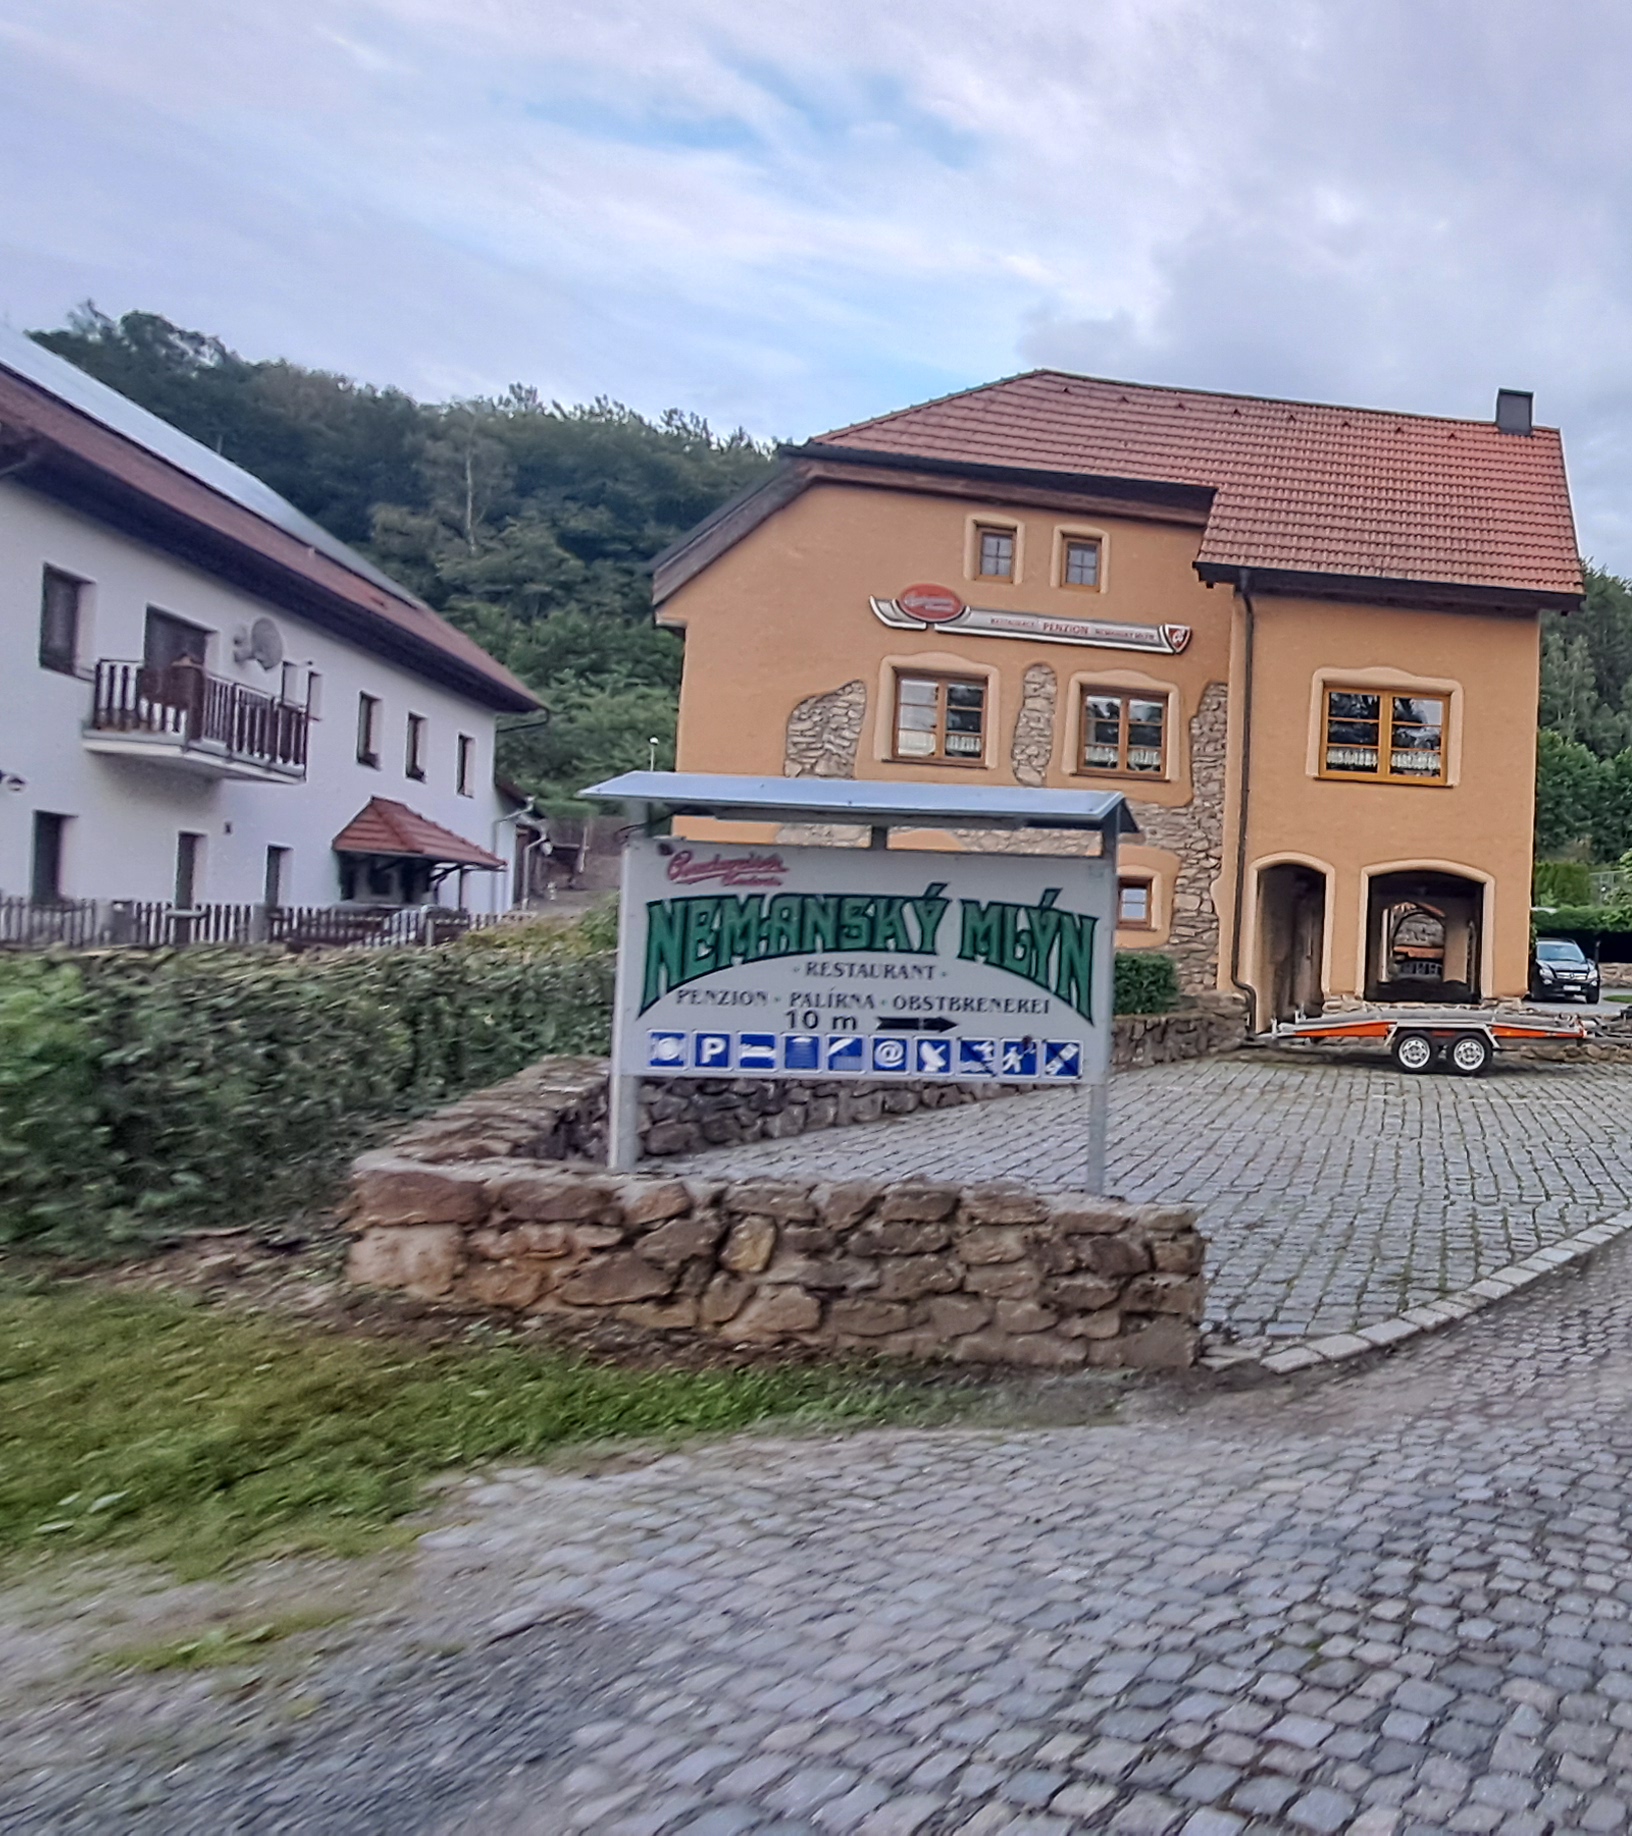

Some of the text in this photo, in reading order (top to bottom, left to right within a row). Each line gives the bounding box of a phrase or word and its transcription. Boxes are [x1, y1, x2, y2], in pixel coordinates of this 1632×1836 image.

[637, 882, 1099, 1026] NEMANSKÝ MLÝN
[805, 961, 936, 980] RESTAURANT
[676, 986, 1049, 1014] PENZION PALÍRNA OBSTBRENEREI
[785, 1009, 857, 1031] 10 m
